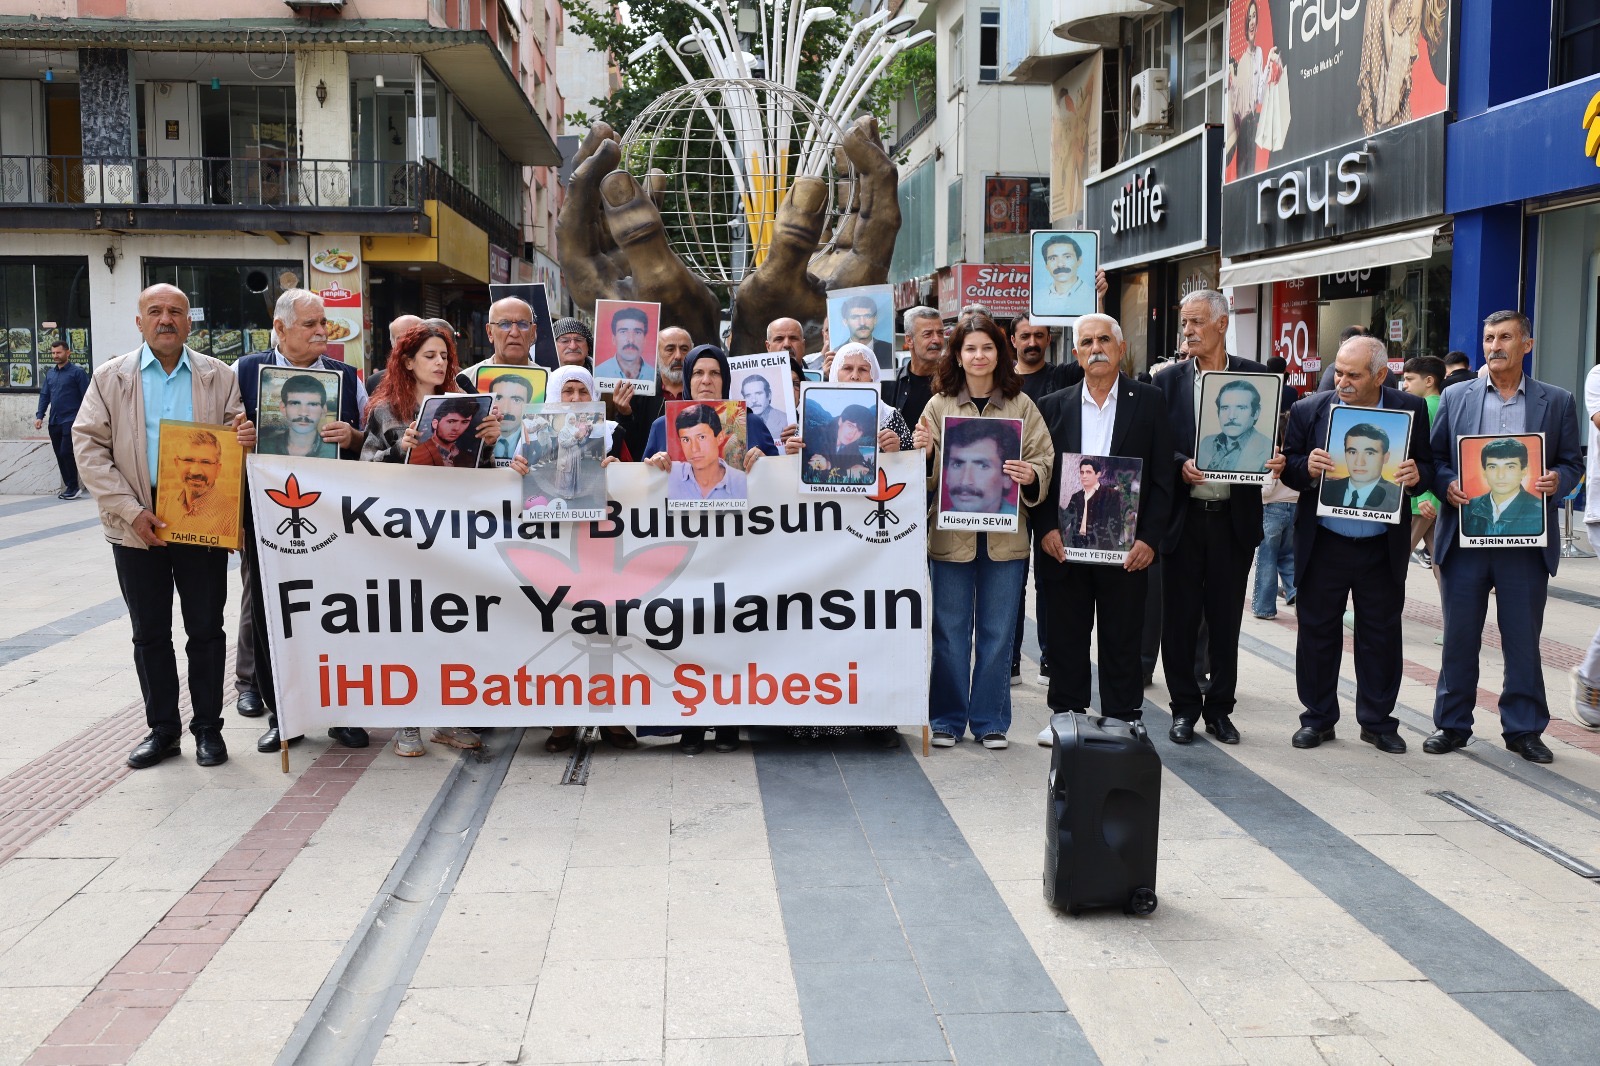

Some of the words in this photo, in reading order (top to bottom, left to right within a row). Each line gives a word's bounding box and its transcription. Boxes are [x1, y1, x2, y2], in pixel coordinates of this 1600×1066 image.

[976, 268, 1028, 286] Şirin
[966, 285, 1029, 297] Collectio
[730, 358, 759, 370] RAHİM
[760, 355, 787, 368] ÇELİK
[1286, 370, 1307, 386] DİRİM
[1240, 474, 1265, 482] ÇELİK
[810, 484, 838, 492] İSMAİL
[840, 485, 867, 493] AĞAYA
[529, 511, 570, 519] MERYEM
[572, 510, 602, 519] BULUT
[1332, 508, 1360, 516] RESUL
[1362, 511, 1392, 520] SAÇAN
[943, 515, 980, 526] Hüseyin
[982, 516, 1012, 526] SEVİM
[846, 524, 863, 540] İNSAN
[894, 522, 918, 541] DERNEĞİ
[171, 532, 197, 542] TAHİR
[199, 535, 220, 545] ELÇİ
[289, 539, 305, 547] 1986
[311, 532, 338, 552] DERNEĞİ
[1469, 538, 1504, 546] M.ŞİRİN
[1089, 551, 1123, 561] YETİŞEN
[278, 579, 502, 639] Failler
[519, 582, 922, 650] Yargılansın
[319, 654, 418, 707] İHD
[440, 664, 651, 706] Batman
[672, 662, 858, 717] Şubesi
